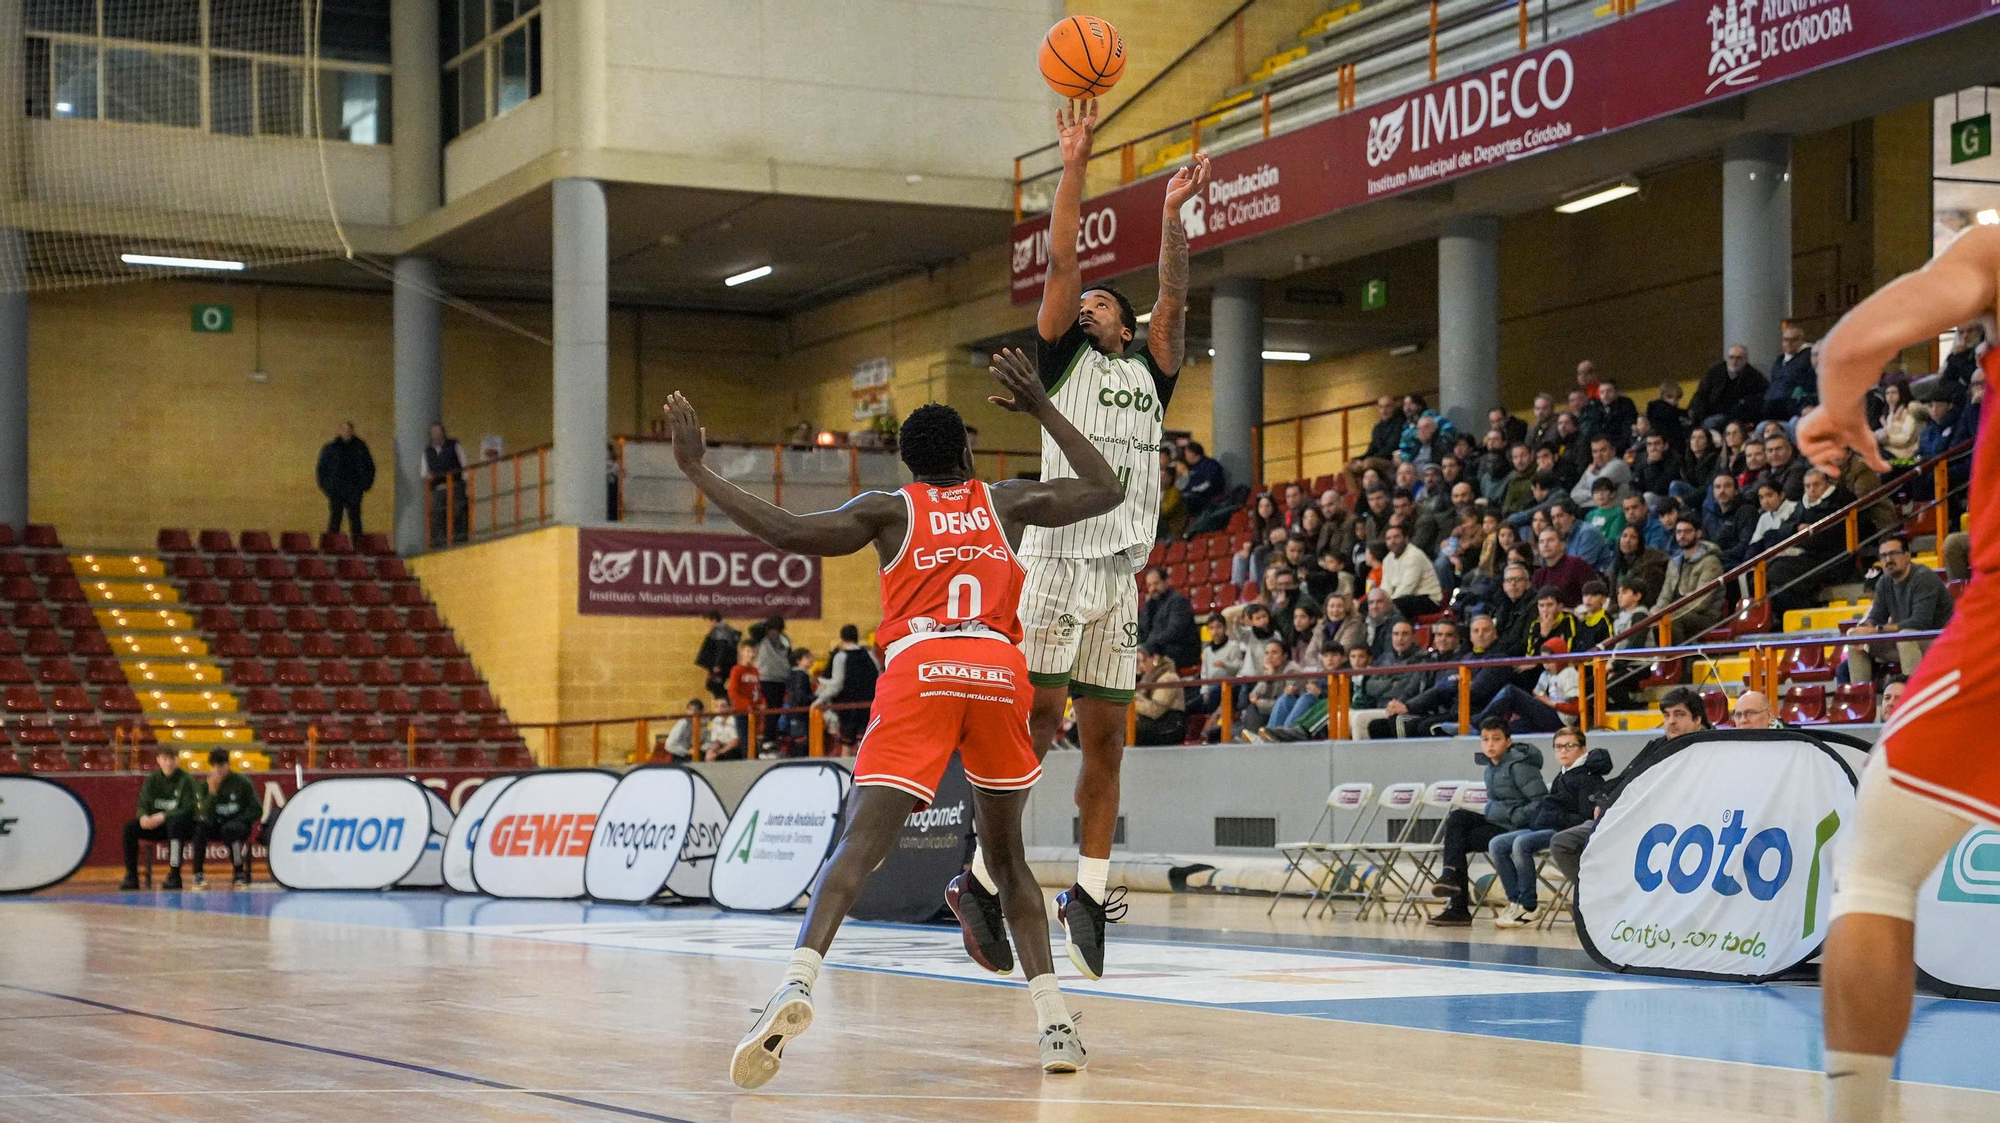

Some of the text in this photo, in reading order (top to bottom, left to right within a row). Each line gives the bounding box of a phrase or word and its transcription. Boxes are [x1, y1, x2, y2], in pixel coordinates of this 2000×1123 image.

[1761, 4, 1852, 59] DE CÓRDOBA
[1411, 49, 1574, 152] IMDECO
[1368, 121, 1572, 195] Instituto Municipal de Deportes Córdoba
[1961, 124, 1979, 156] G
[1209, 164, 1279, 206] Diputación
[1209, 192, 1280, 232] de Córdoba
[1368, 280, 1380, 304] F
[1099, 387, 1153, 413] coto
[929, 507, 990, 535] DENG
[642, 549, 813, 588] IMDECO
[590, 589, 635, 603] Instituto
[639, 591, 693, 606] Municipal
[712, 592, 762, 607] Deportes
[947, 574, 982, 620] 0
[920, 690, 966, 699] MANUFACTURAS
[966, 692, 998, 702] METÁLICAS
[292, 804, 405, 852] simon
[764, 812, 784, 826] Junta
[1634, 809, 1793, 901] coto
